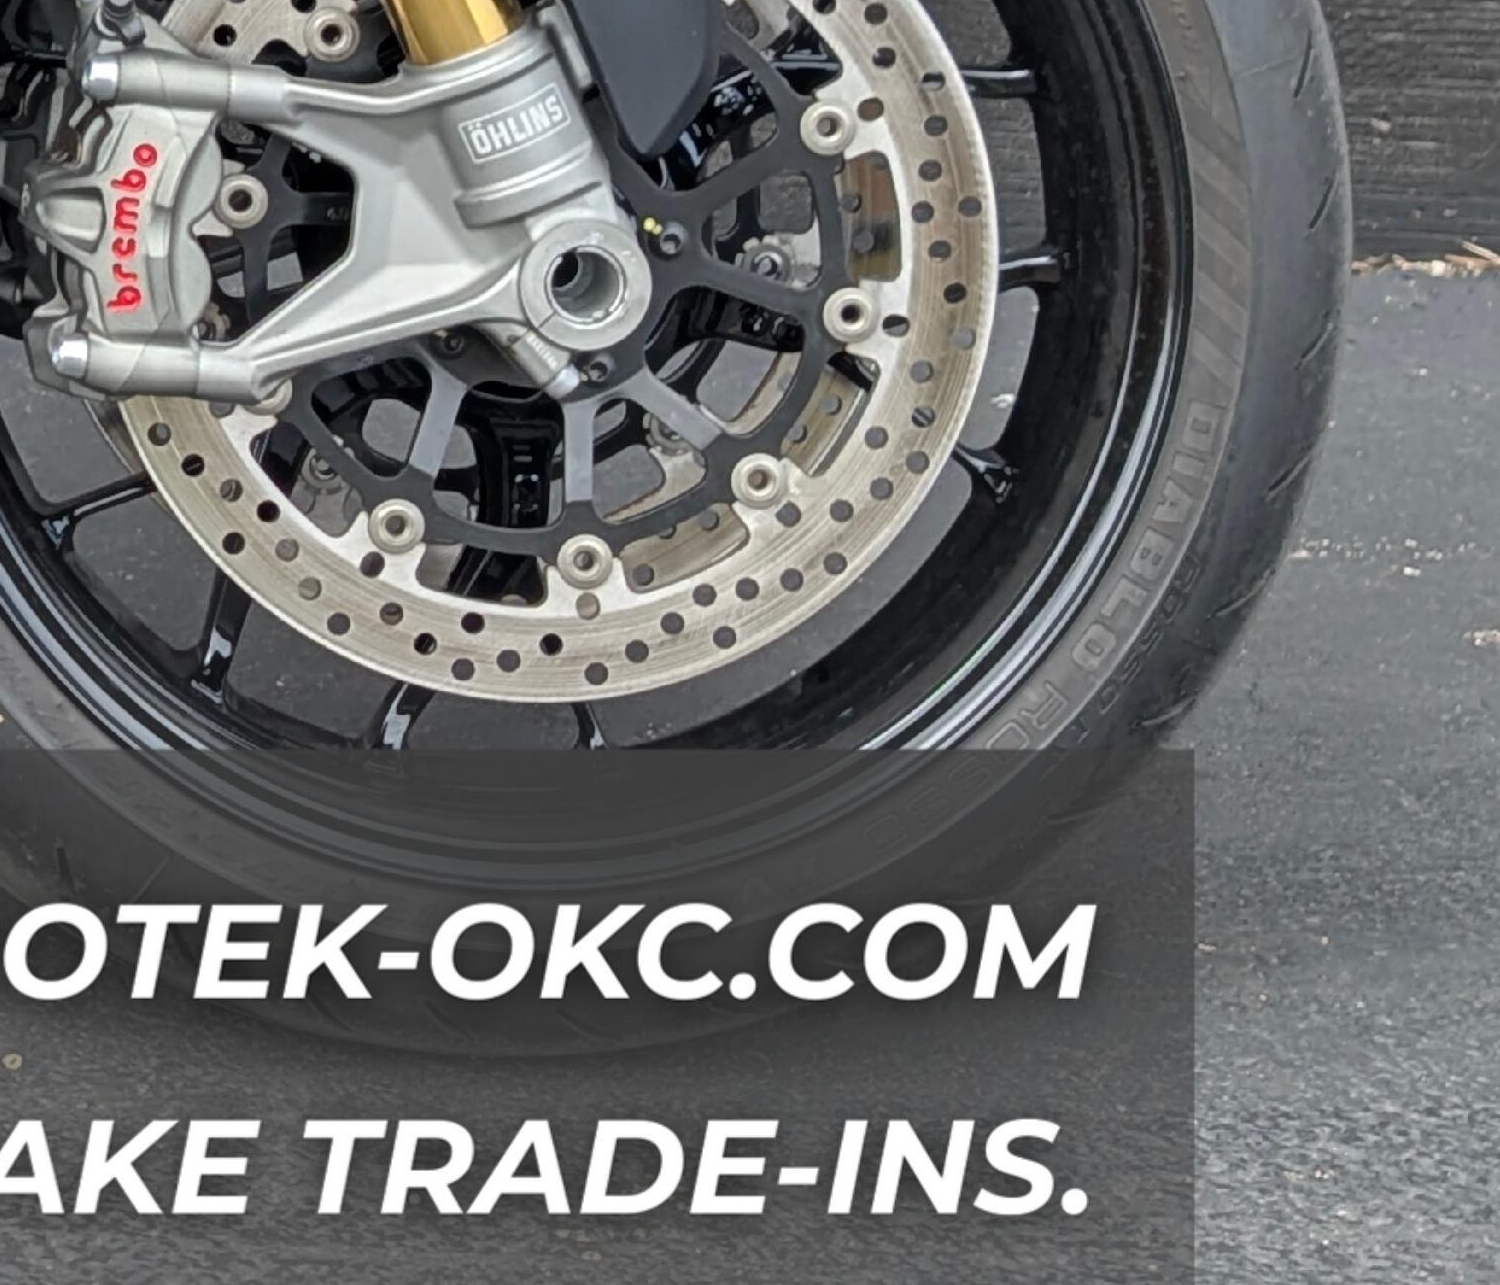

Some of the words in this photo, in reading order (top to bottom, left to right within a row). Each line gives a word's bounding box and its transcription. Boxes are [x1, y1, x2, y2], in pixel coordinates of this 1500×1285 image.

[468, 91, 565, 157] ÖHLINS
[106, 142, 160, 314] brembo
[1071, 399, 1227, 674] DIABLO
